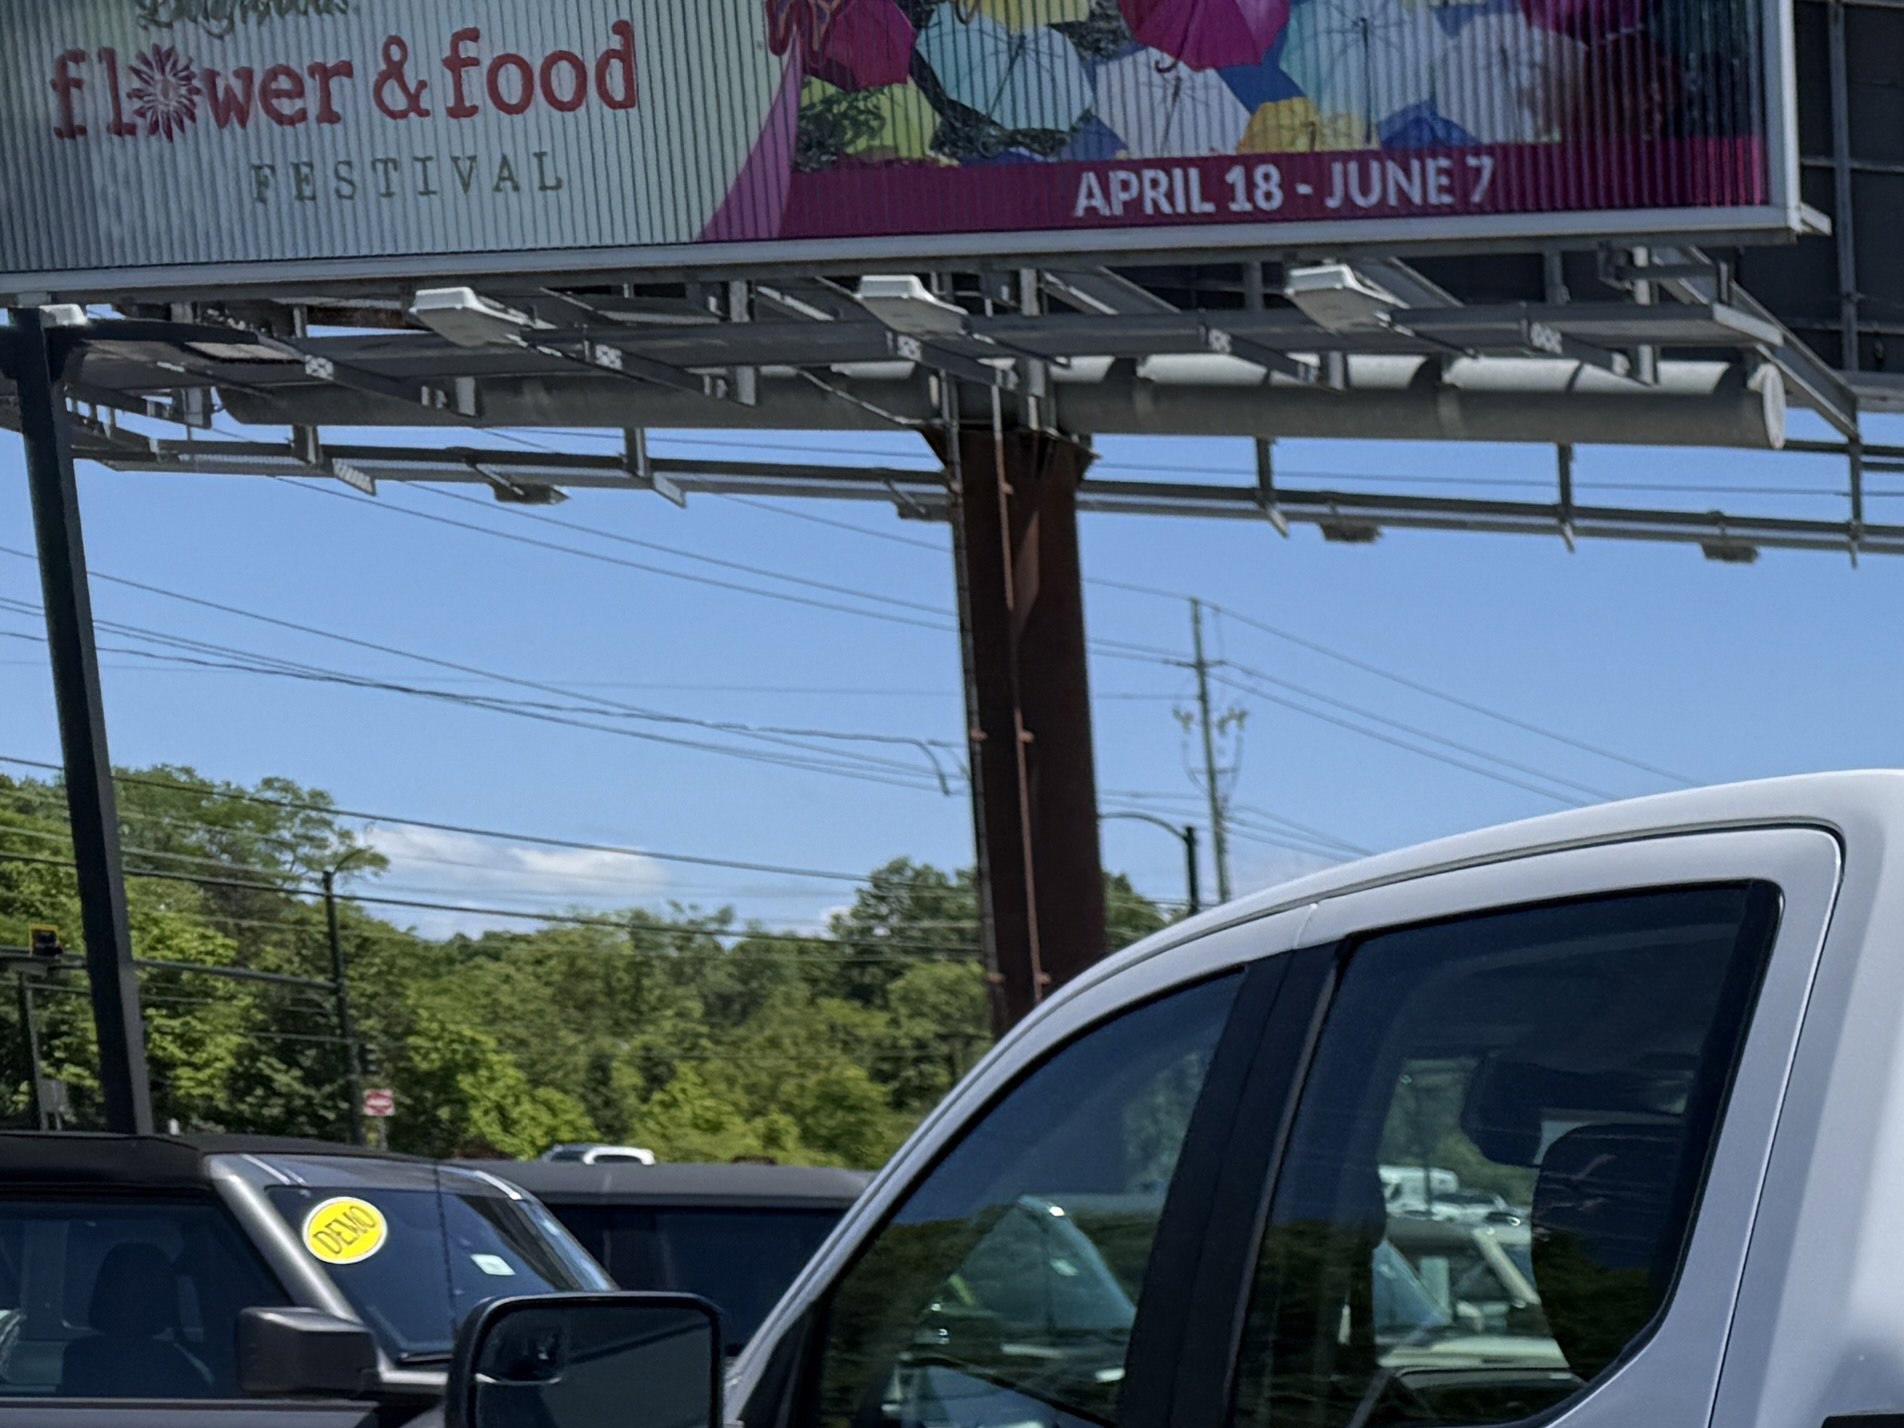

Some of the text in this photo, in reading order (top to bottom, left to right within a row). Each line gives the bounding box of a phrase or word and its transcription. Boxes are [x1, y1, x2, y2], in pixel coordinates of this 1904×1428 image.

[373, 35, 430, 120] &
[442, 19, 637, 119] food
[251, 151, 563, 204] FESTIVAL
[1074, 166, 1216, 218] APRIL
[1224, 163, 1284, 212] 18
[1324, 157, 1456, 209] JUNE
[1465, 155, 1495, 203] 7
[313, 1206, 376, 1255] DEMO
